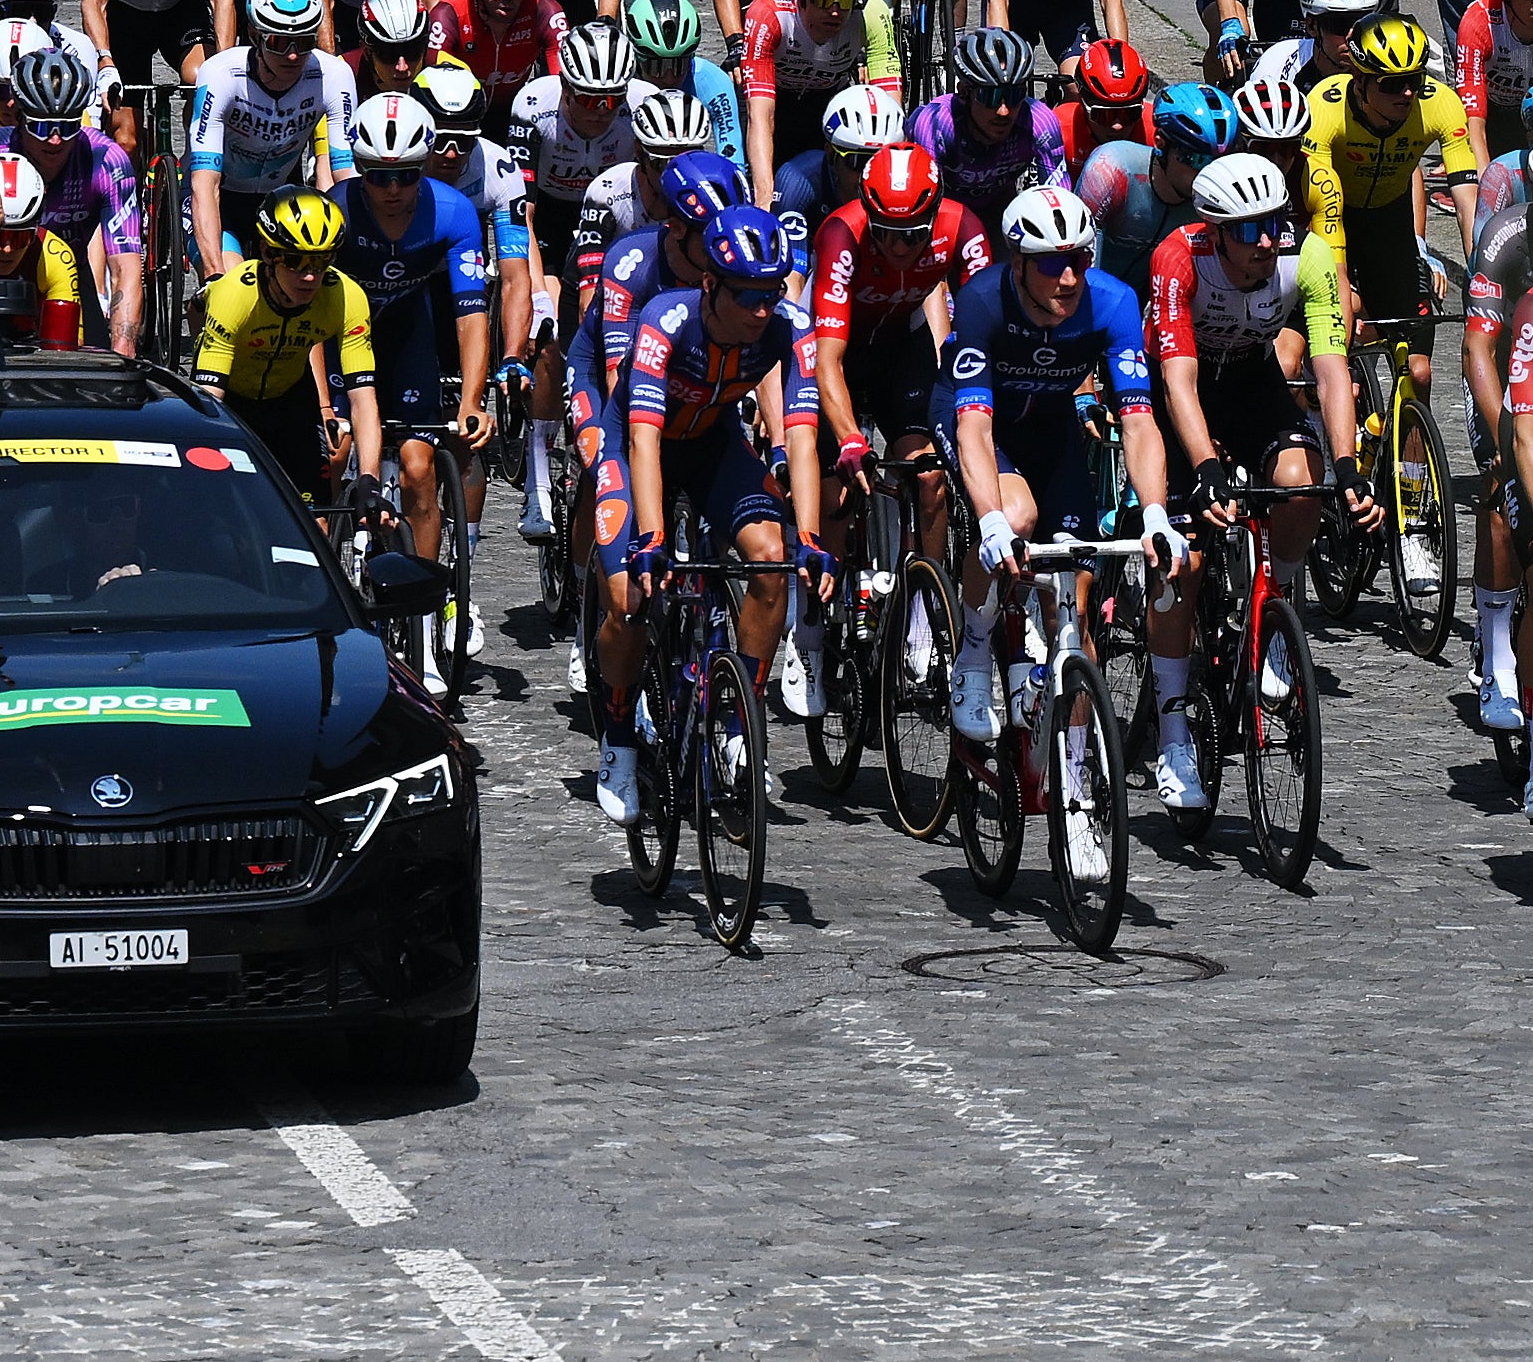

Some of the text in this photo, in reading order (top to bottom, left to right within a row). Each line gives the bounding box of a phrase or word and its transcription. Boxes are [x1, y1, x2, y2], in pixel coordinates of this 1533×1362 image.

[196, 90, 215, 145] MERIDA
[229, 107, 320, 136] BAHRAIN
[1369, 150, 1416, 165] VISMA
[1310, 168, 1341, 235] Cofidis
[919, 251, 947, 267] CAPS
[603, 287, 628, 307] PIC
[269, 334, 315, 348] VISMA
[639, 333, 669, 357] PIC
[996, 361, 1087, 377] Groupama
[96, 447, 105, 456] 1
[62, 934, 180, 963] AI 51004
